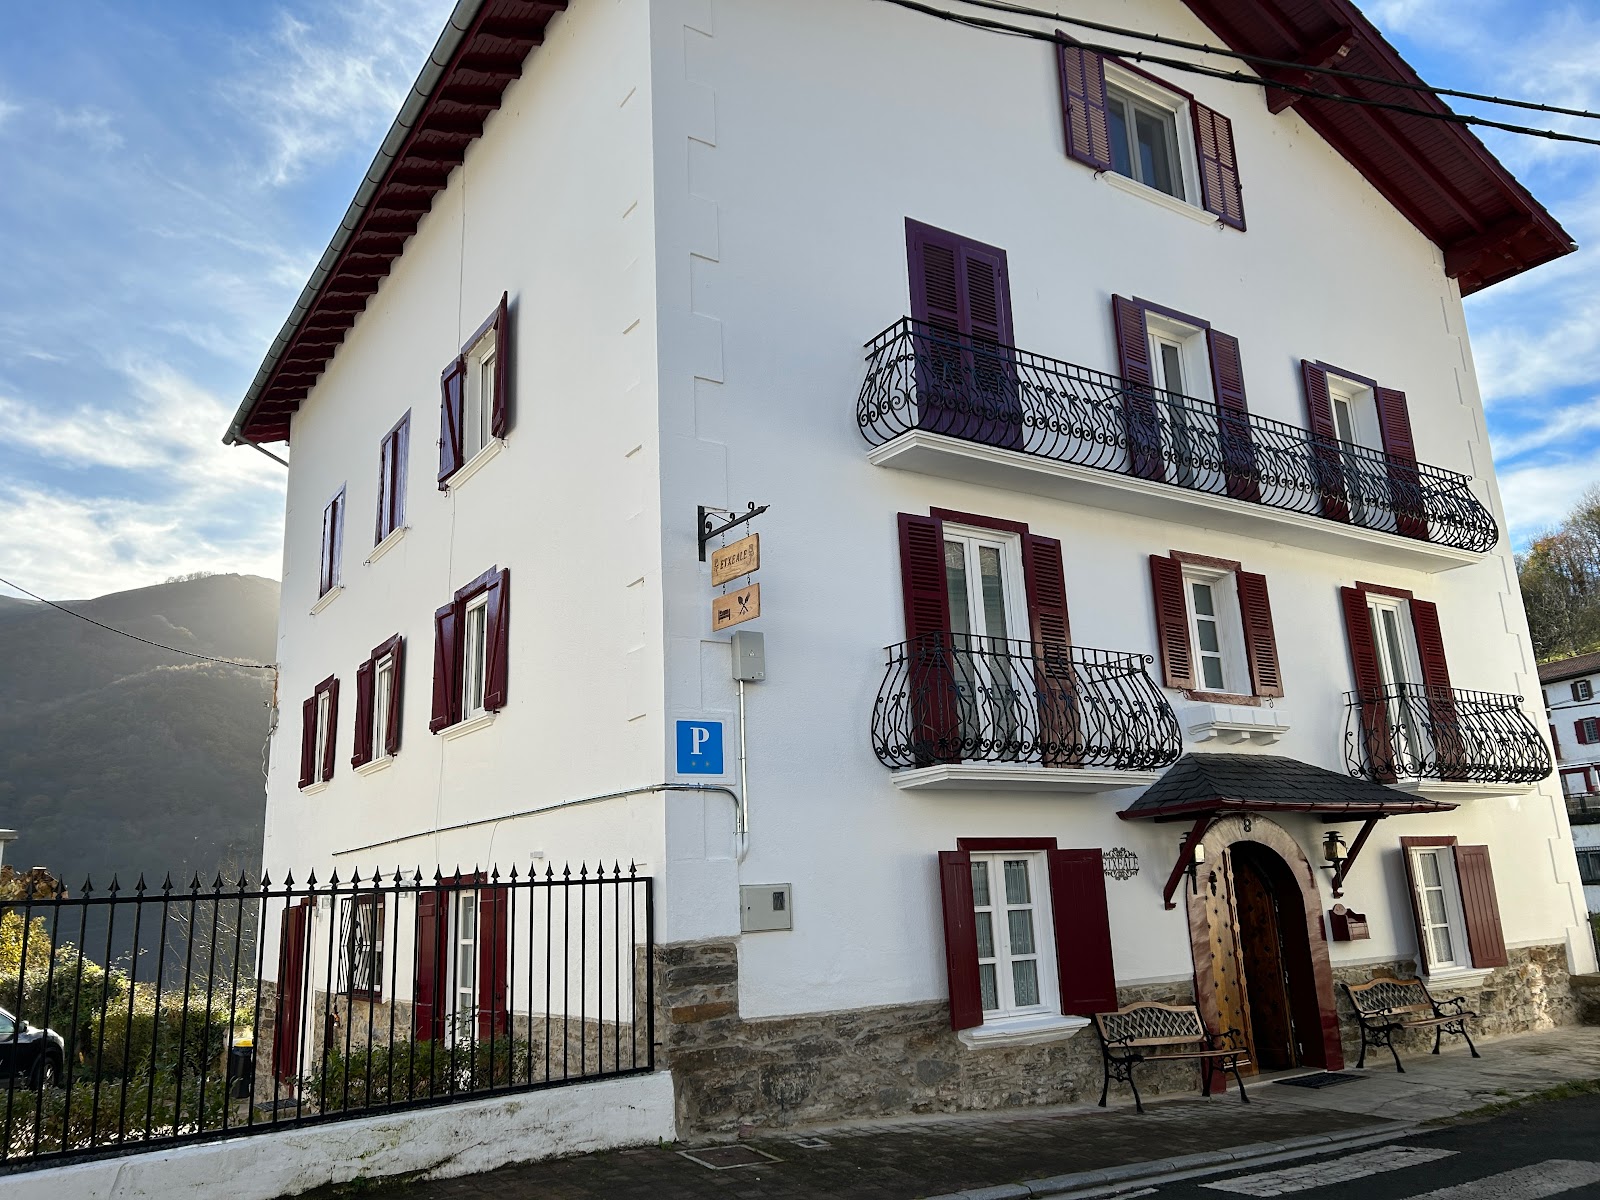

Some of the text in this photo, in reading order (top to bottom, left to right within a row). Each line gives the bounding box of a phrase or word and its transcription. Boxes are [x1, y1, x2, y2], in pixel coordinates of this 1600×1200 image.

[719, 550, 748, 569] ETXEALE
[690, 727, 709, 755] P
[1244, 818, 1252, 832] 8
[1103, 857, 1139, 870] ETXEALE
